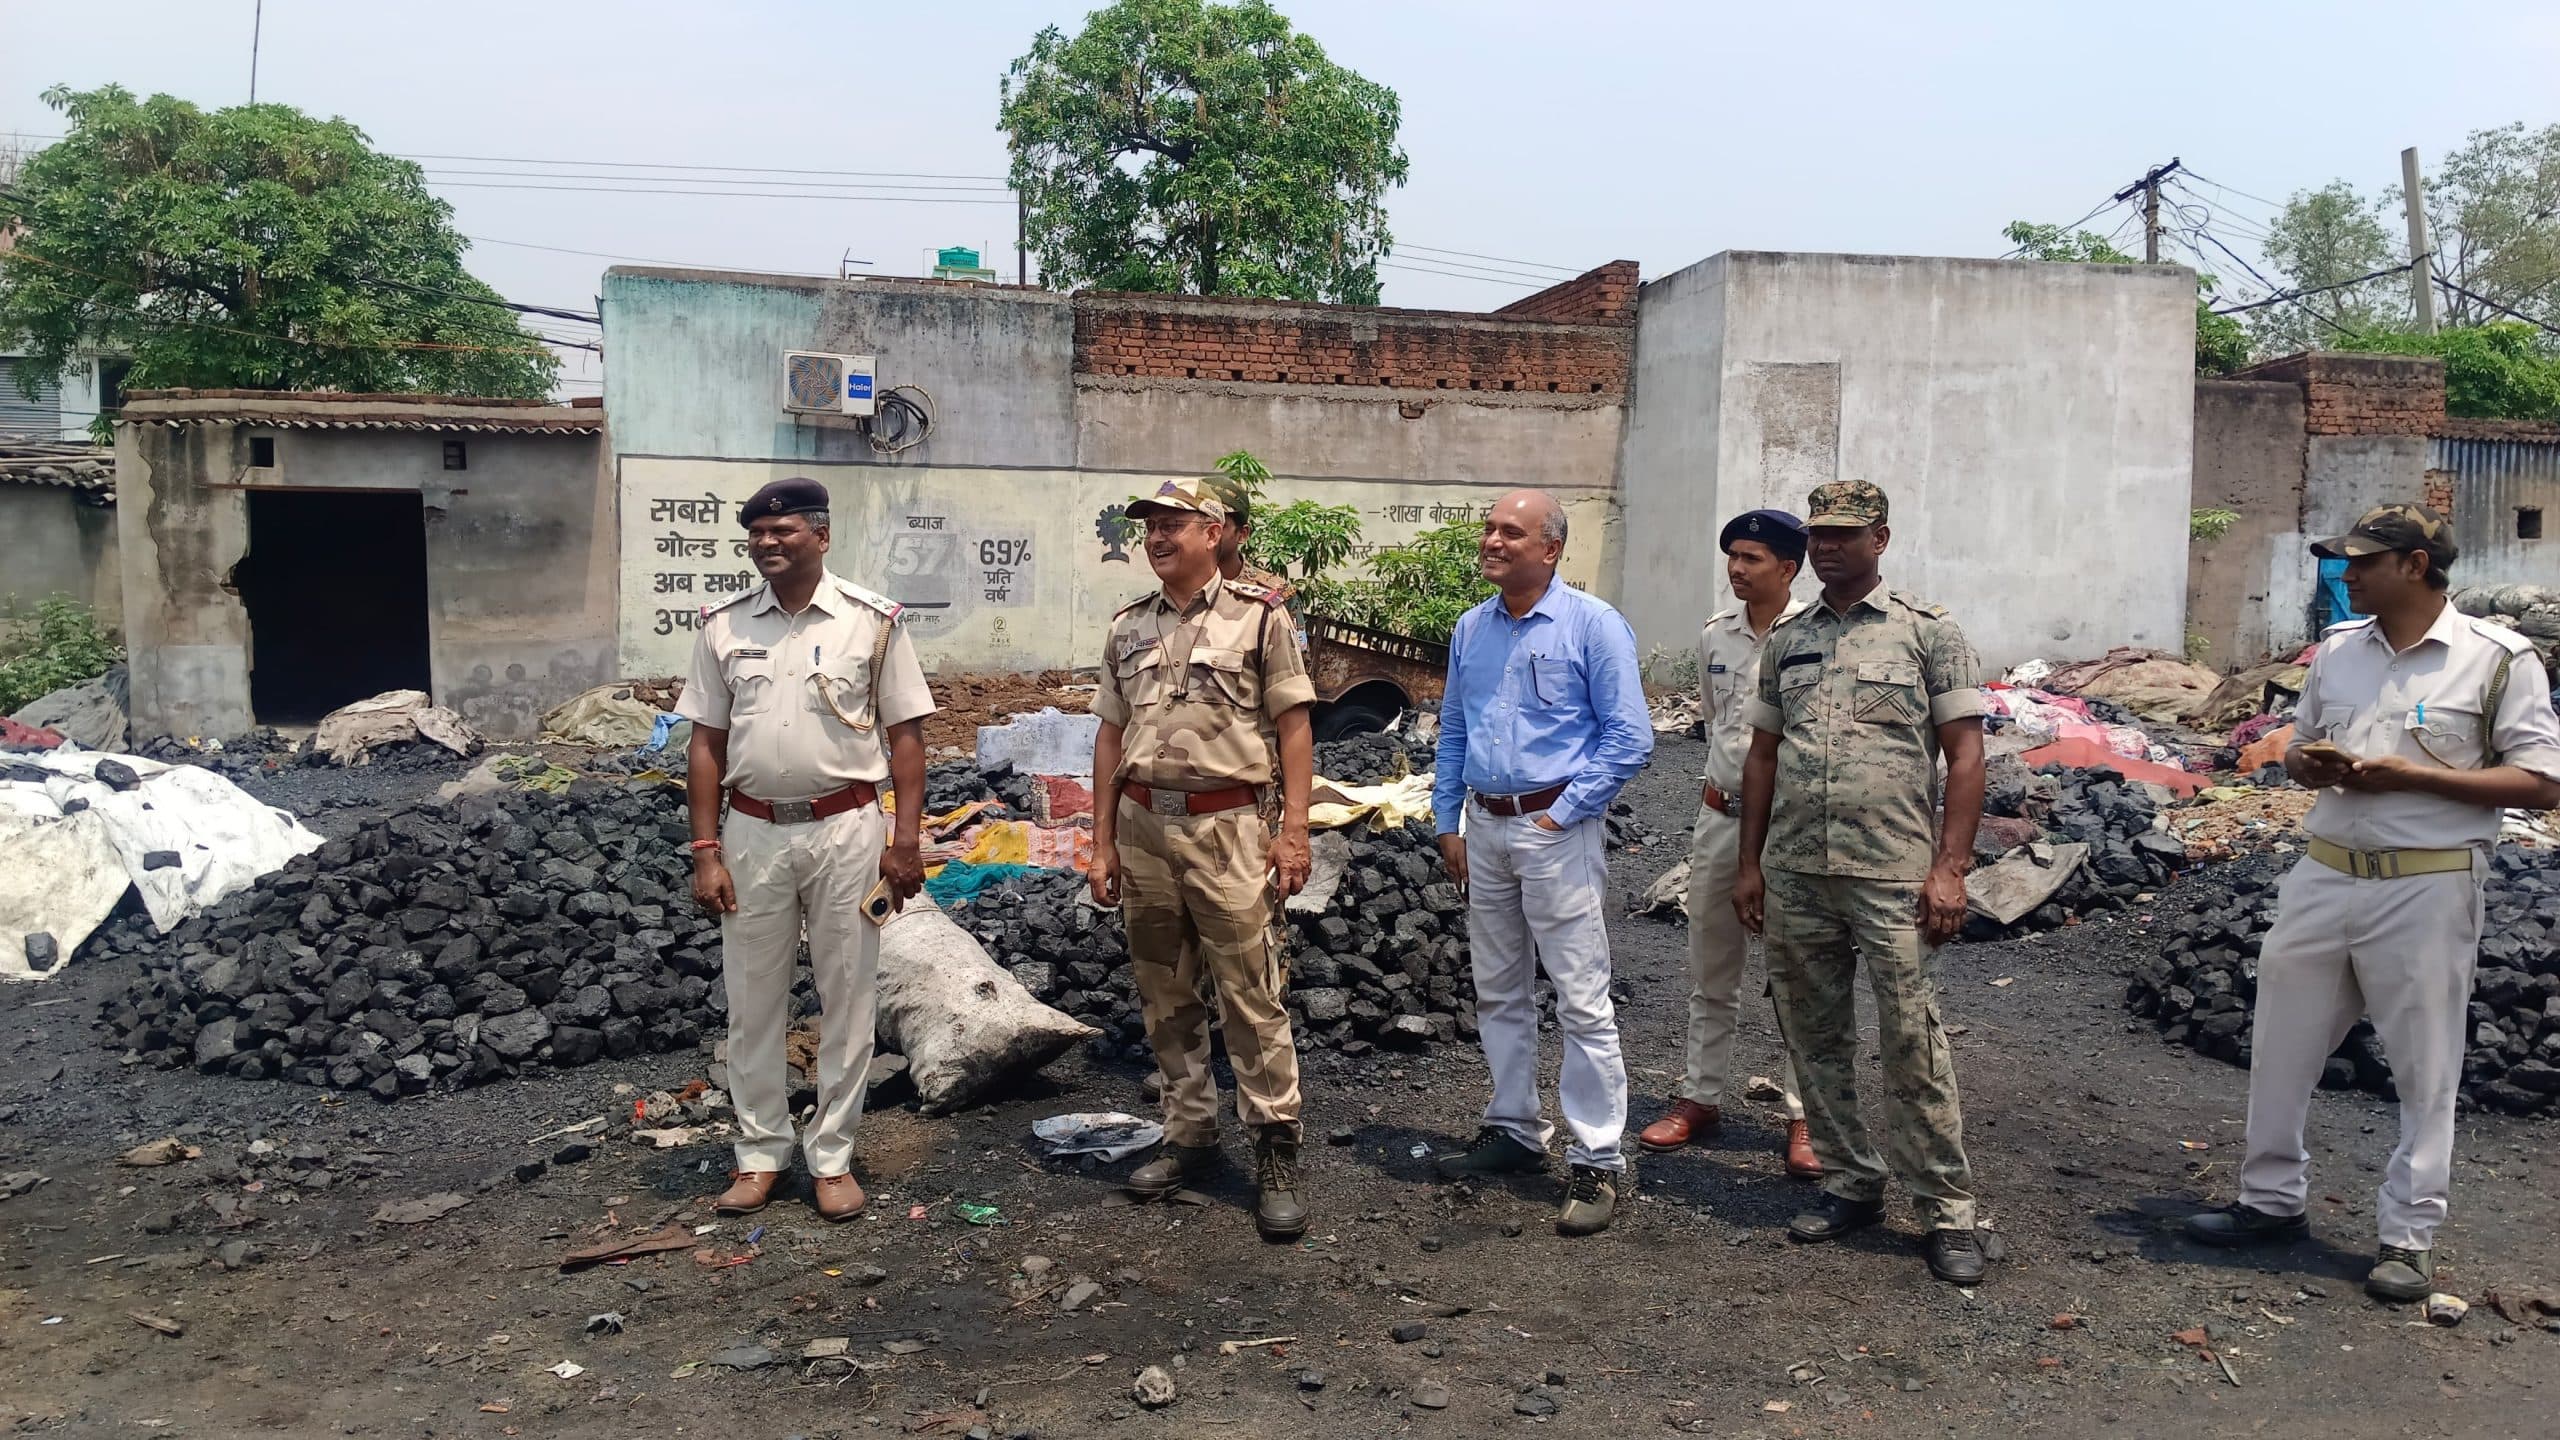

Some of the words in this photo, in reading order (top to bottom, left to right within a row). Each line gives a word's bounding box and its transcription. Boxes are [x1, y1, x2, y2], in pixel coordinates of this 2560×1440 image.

[849, 383, 872, 392] Haier
[650, 492, 727, 524] सबसे
[1429, 502, 1474, 525] बोकारो
[906, 516, 946, 530] ब्याज
[654, 531, 719, 559] गोल्ड
[979, 539, 1032, 566] 69%
[653, 572, 697, 593] अब
[703, 570, 755, 593] सभी
[983, 568, 1015, 585] प्रति
[984, 586, 1011, 603] वर्ष
